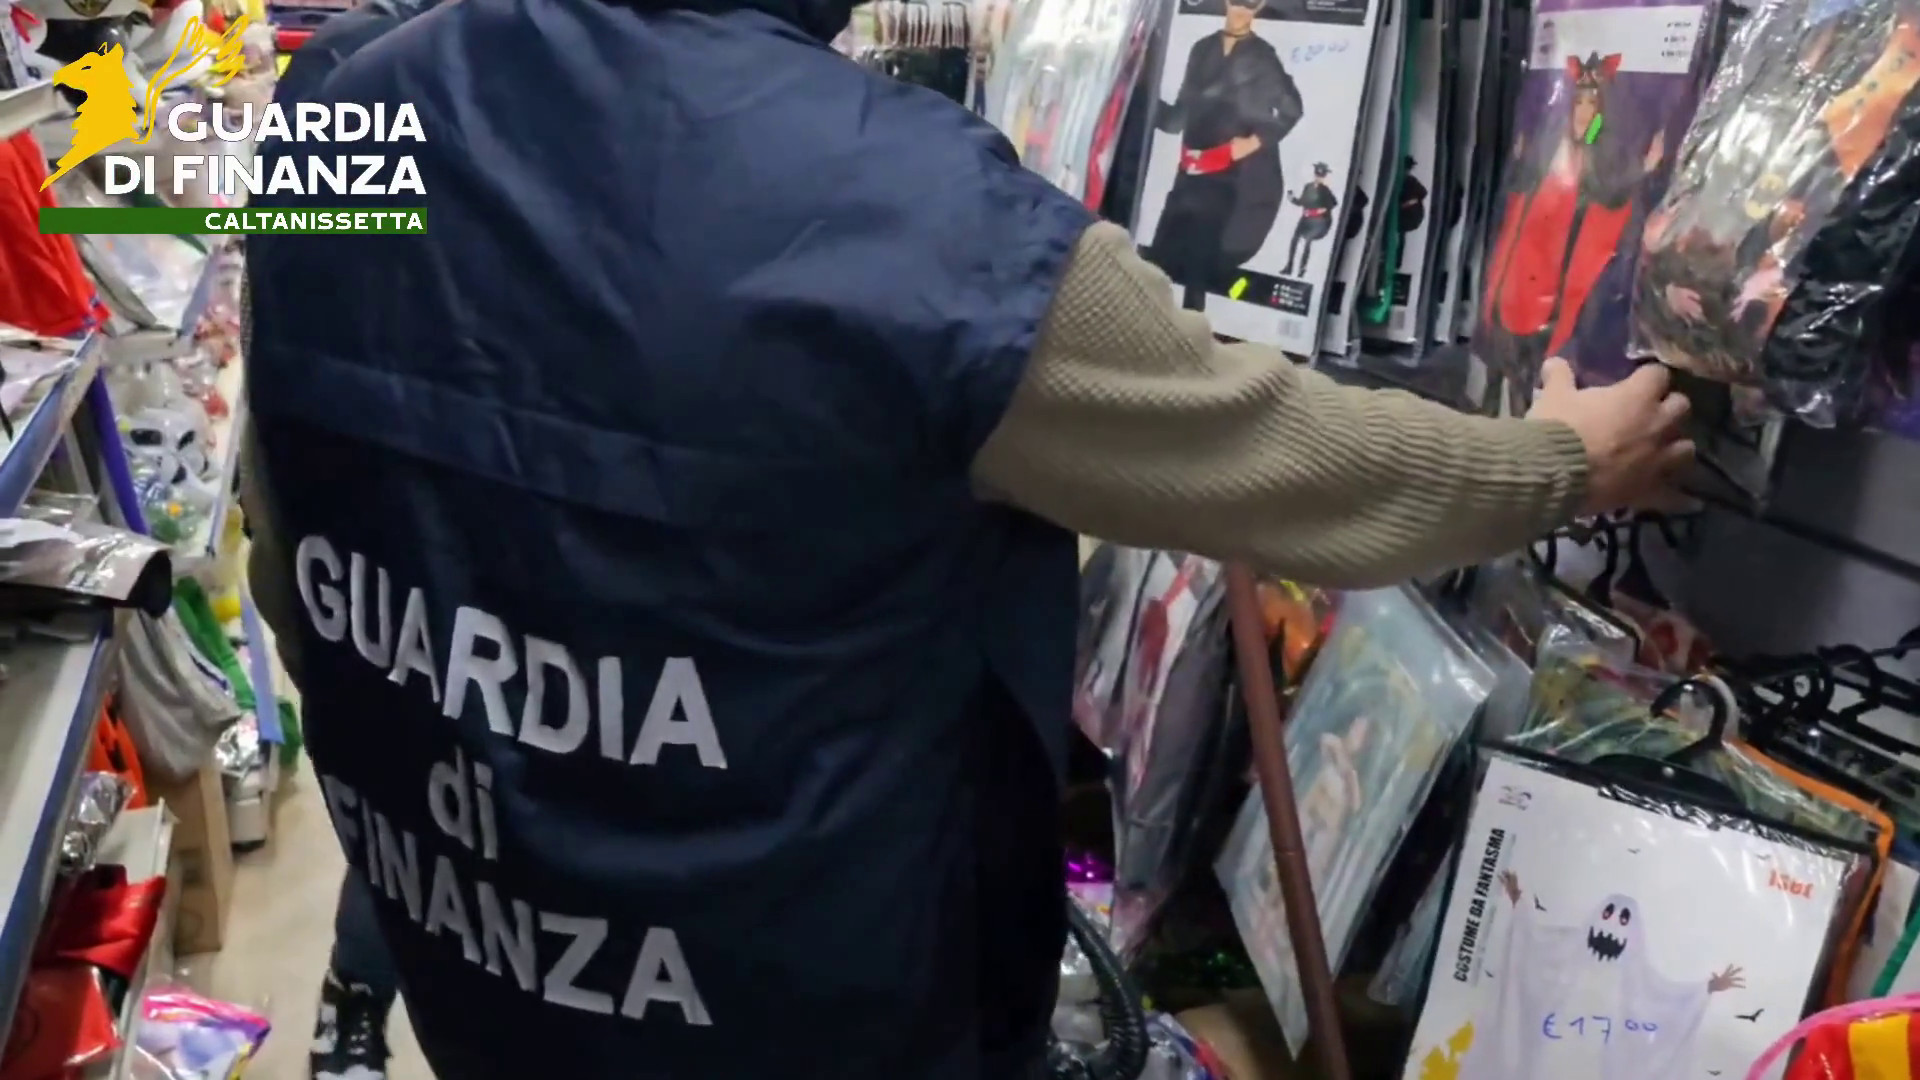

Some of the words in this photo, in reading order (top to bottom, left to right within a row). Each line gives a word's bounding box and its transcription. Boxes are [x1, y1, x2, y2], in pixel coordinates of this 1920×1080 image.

[296, 535, 728, 769] GUARDIA
[427, 746, 498, 859] di
[322, 773, 713, 1025] FINANZA
[1469, 898, 1487, 919] DA
[1474, 828, 1506, 899] FANTASMA
[1453, 917, 1481, 983] COSTUME
